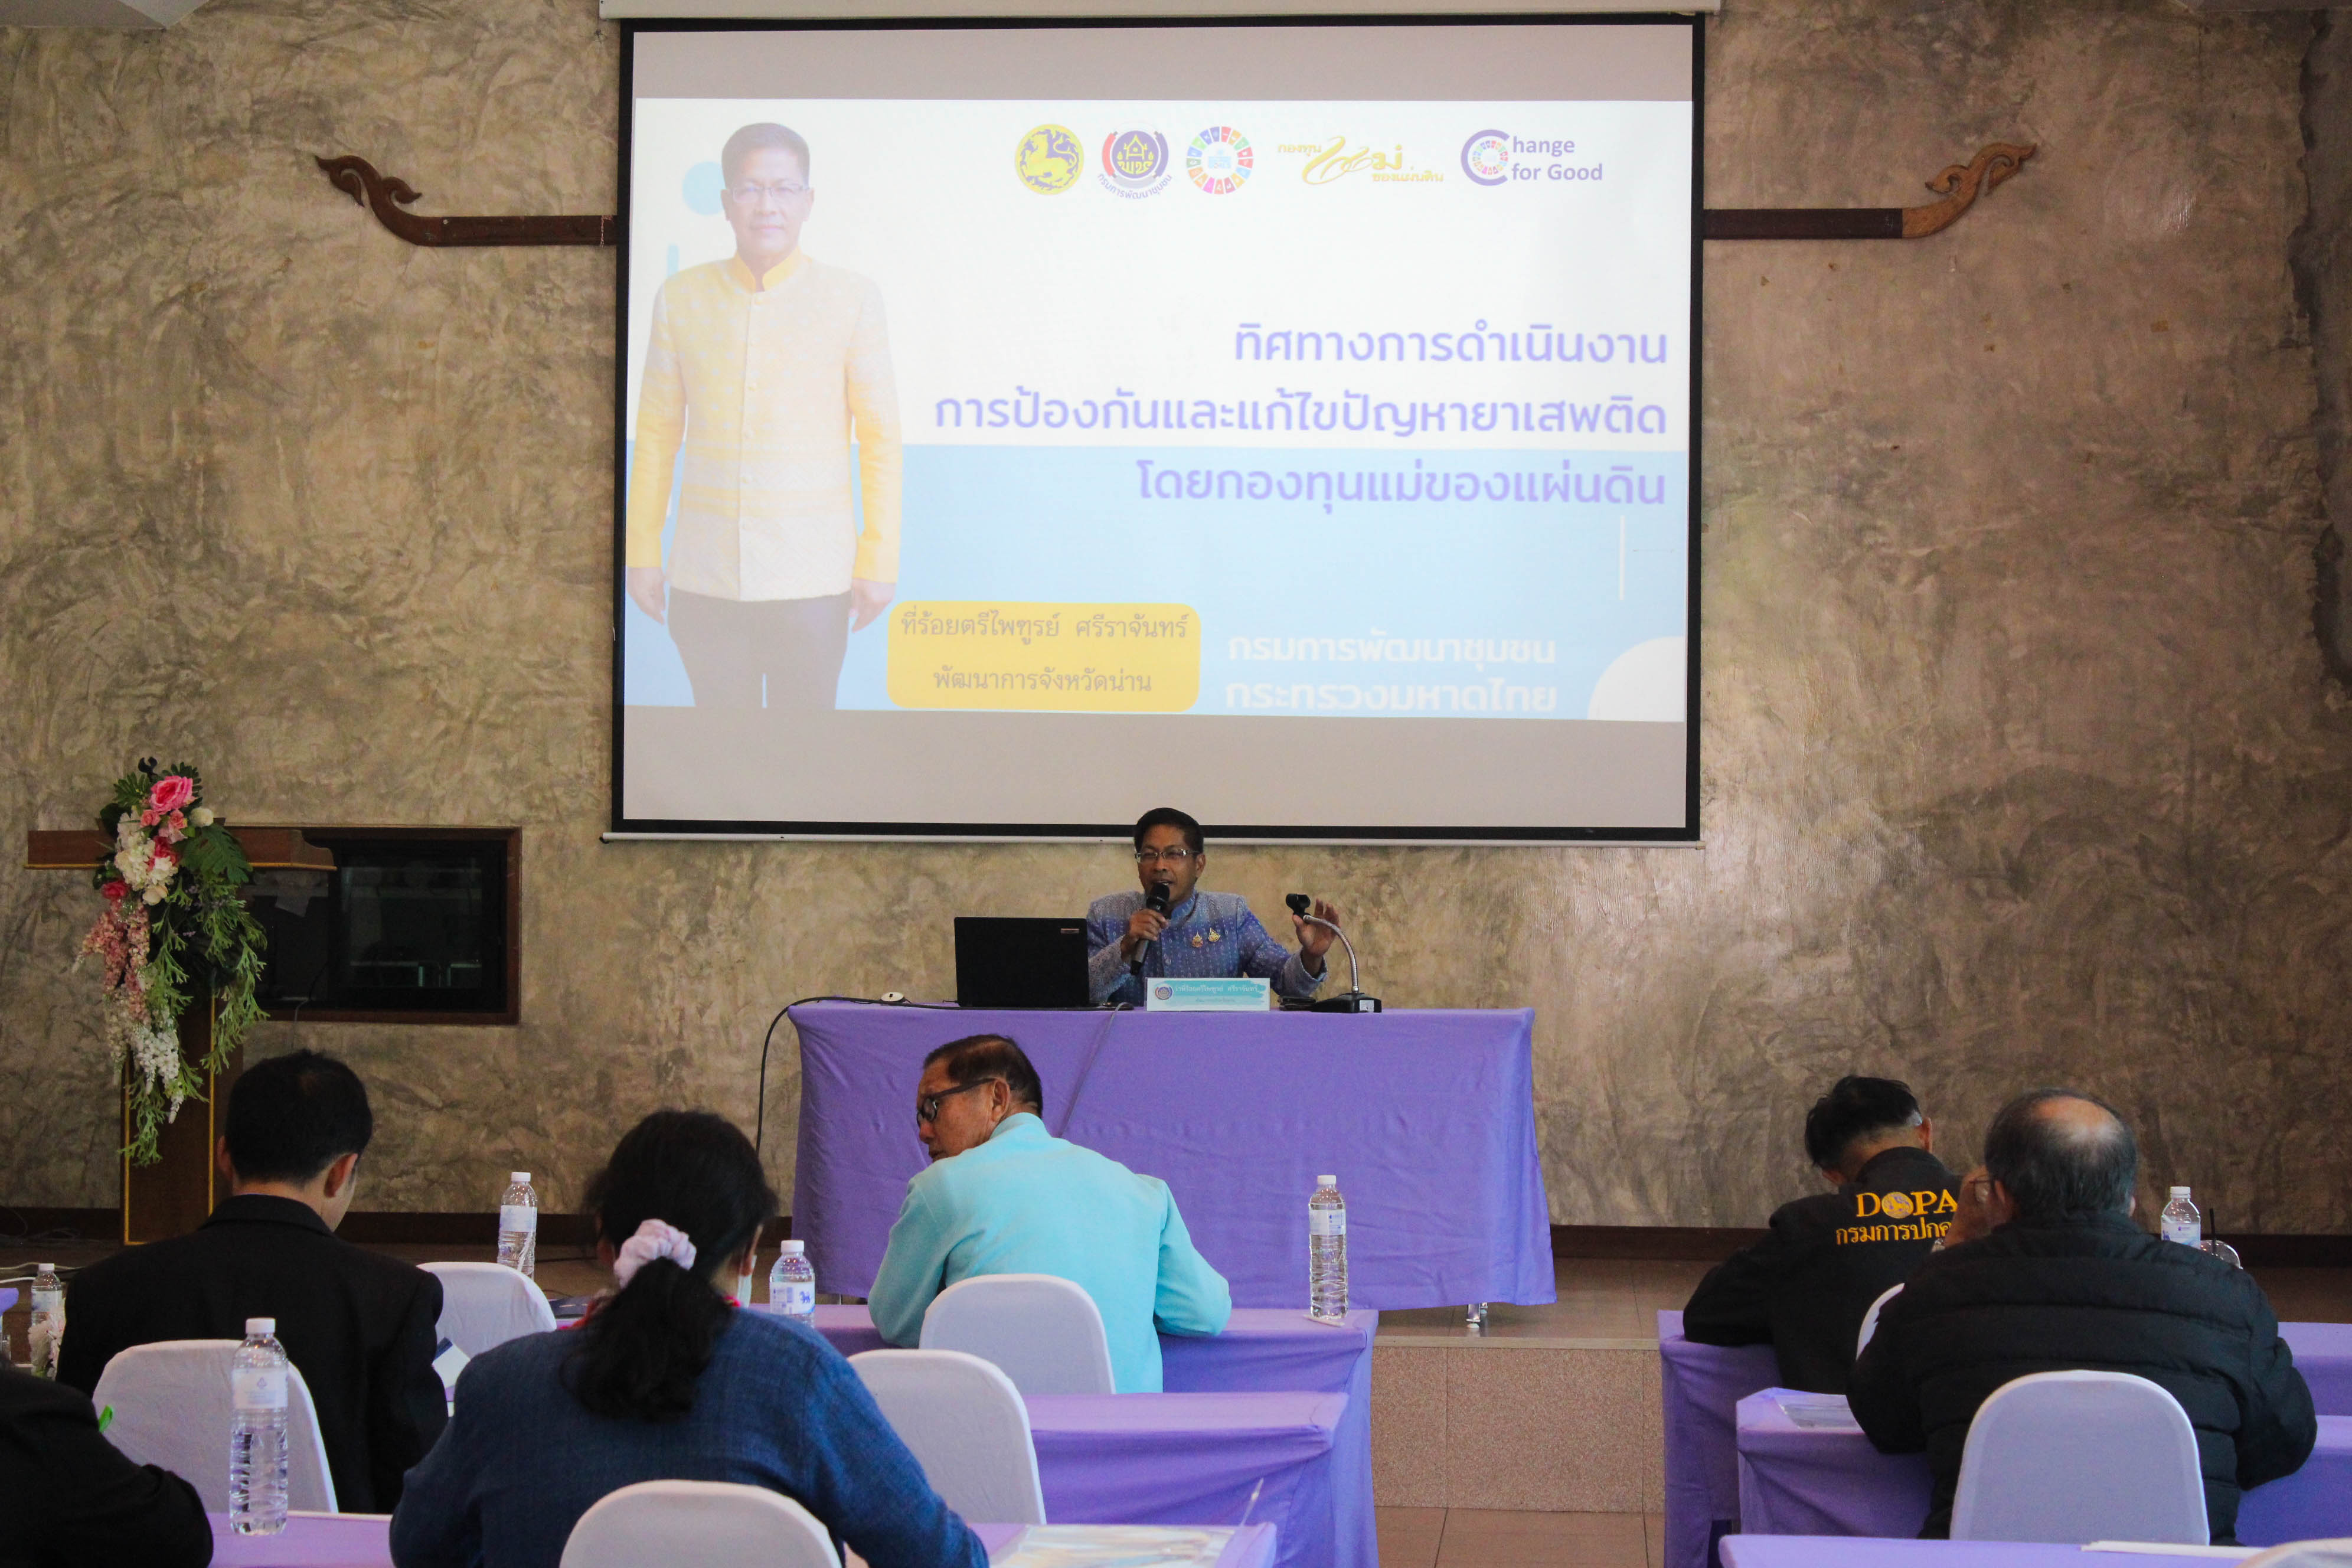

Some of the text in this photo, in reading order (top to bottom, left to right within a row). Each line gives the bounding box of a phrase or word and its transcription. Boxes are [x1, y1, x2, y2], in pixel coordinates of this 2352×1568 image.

[1511, 163, 1603, 181] for Good
[1235, 319, 1667, 363] ทิศทางการดำเนินงาน
[936, 386, 1666, 437] การป้องกันและแก้ไขปัญหายาเสพติด
[1137, 459, 1665, 514] โดยกองทุนแม่ของแผ่นดิน
[901, 605, 1188, 645] ที่ร้อยตรีไพฑูรย์ ศรีราจันทร์
[1229, 628, 1556, 671] กรมการพัฒนาชุมชน
[934, 665, 1151, 691] พัฒนาการจังหวัดน่าน
[1225, 677, 1557, 712] กระทรวงมหาดไทย
